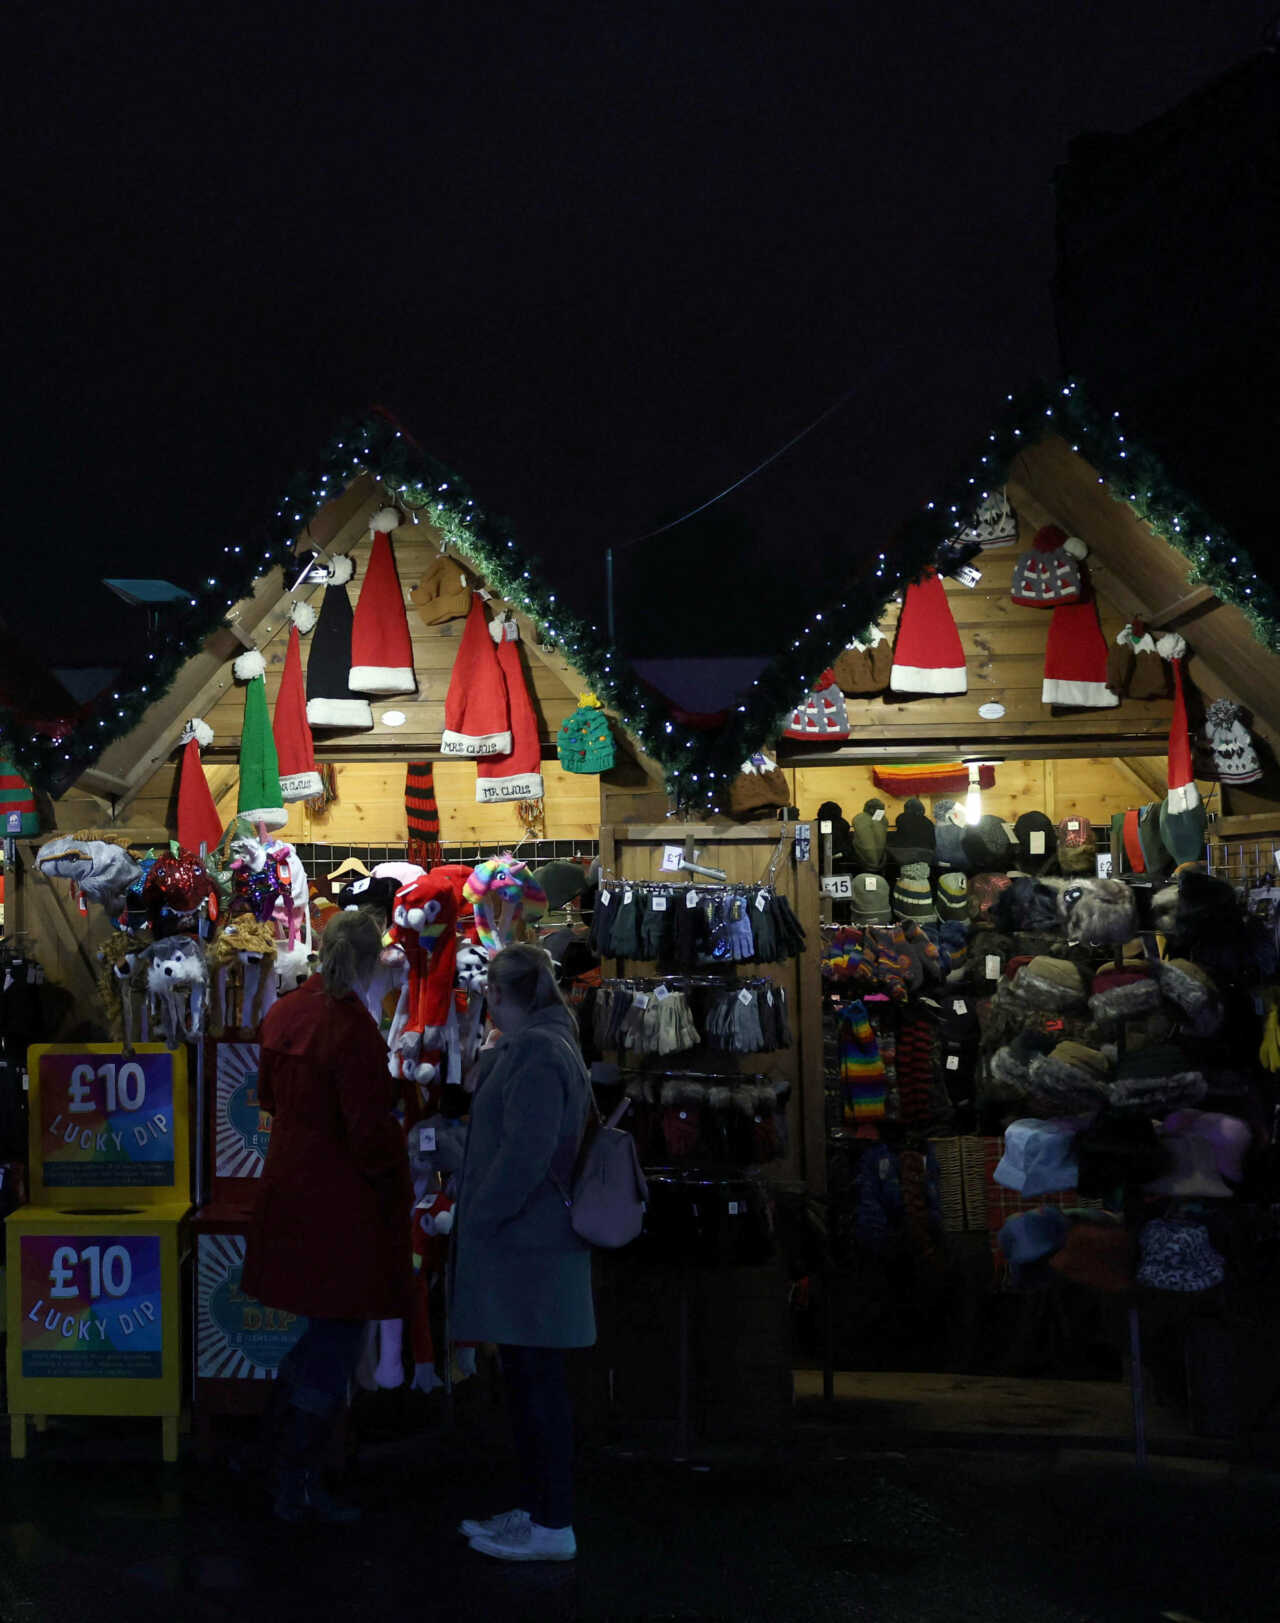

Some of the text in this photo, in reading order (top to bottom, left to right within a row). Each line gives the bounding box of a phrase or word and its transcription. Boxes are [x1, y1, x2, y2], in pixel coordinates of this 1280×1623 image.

[466, 743, 497, 754] CLAUS
[501, 785, 531, 796] CLAUS
[68, 1062, 146, 1113] £10
[48, 1113, 168, 1151] LUCKY DIP
[48, 1245, 132, 1299] £10
[28, 1299, 156, 1341] LUCKY DIP
